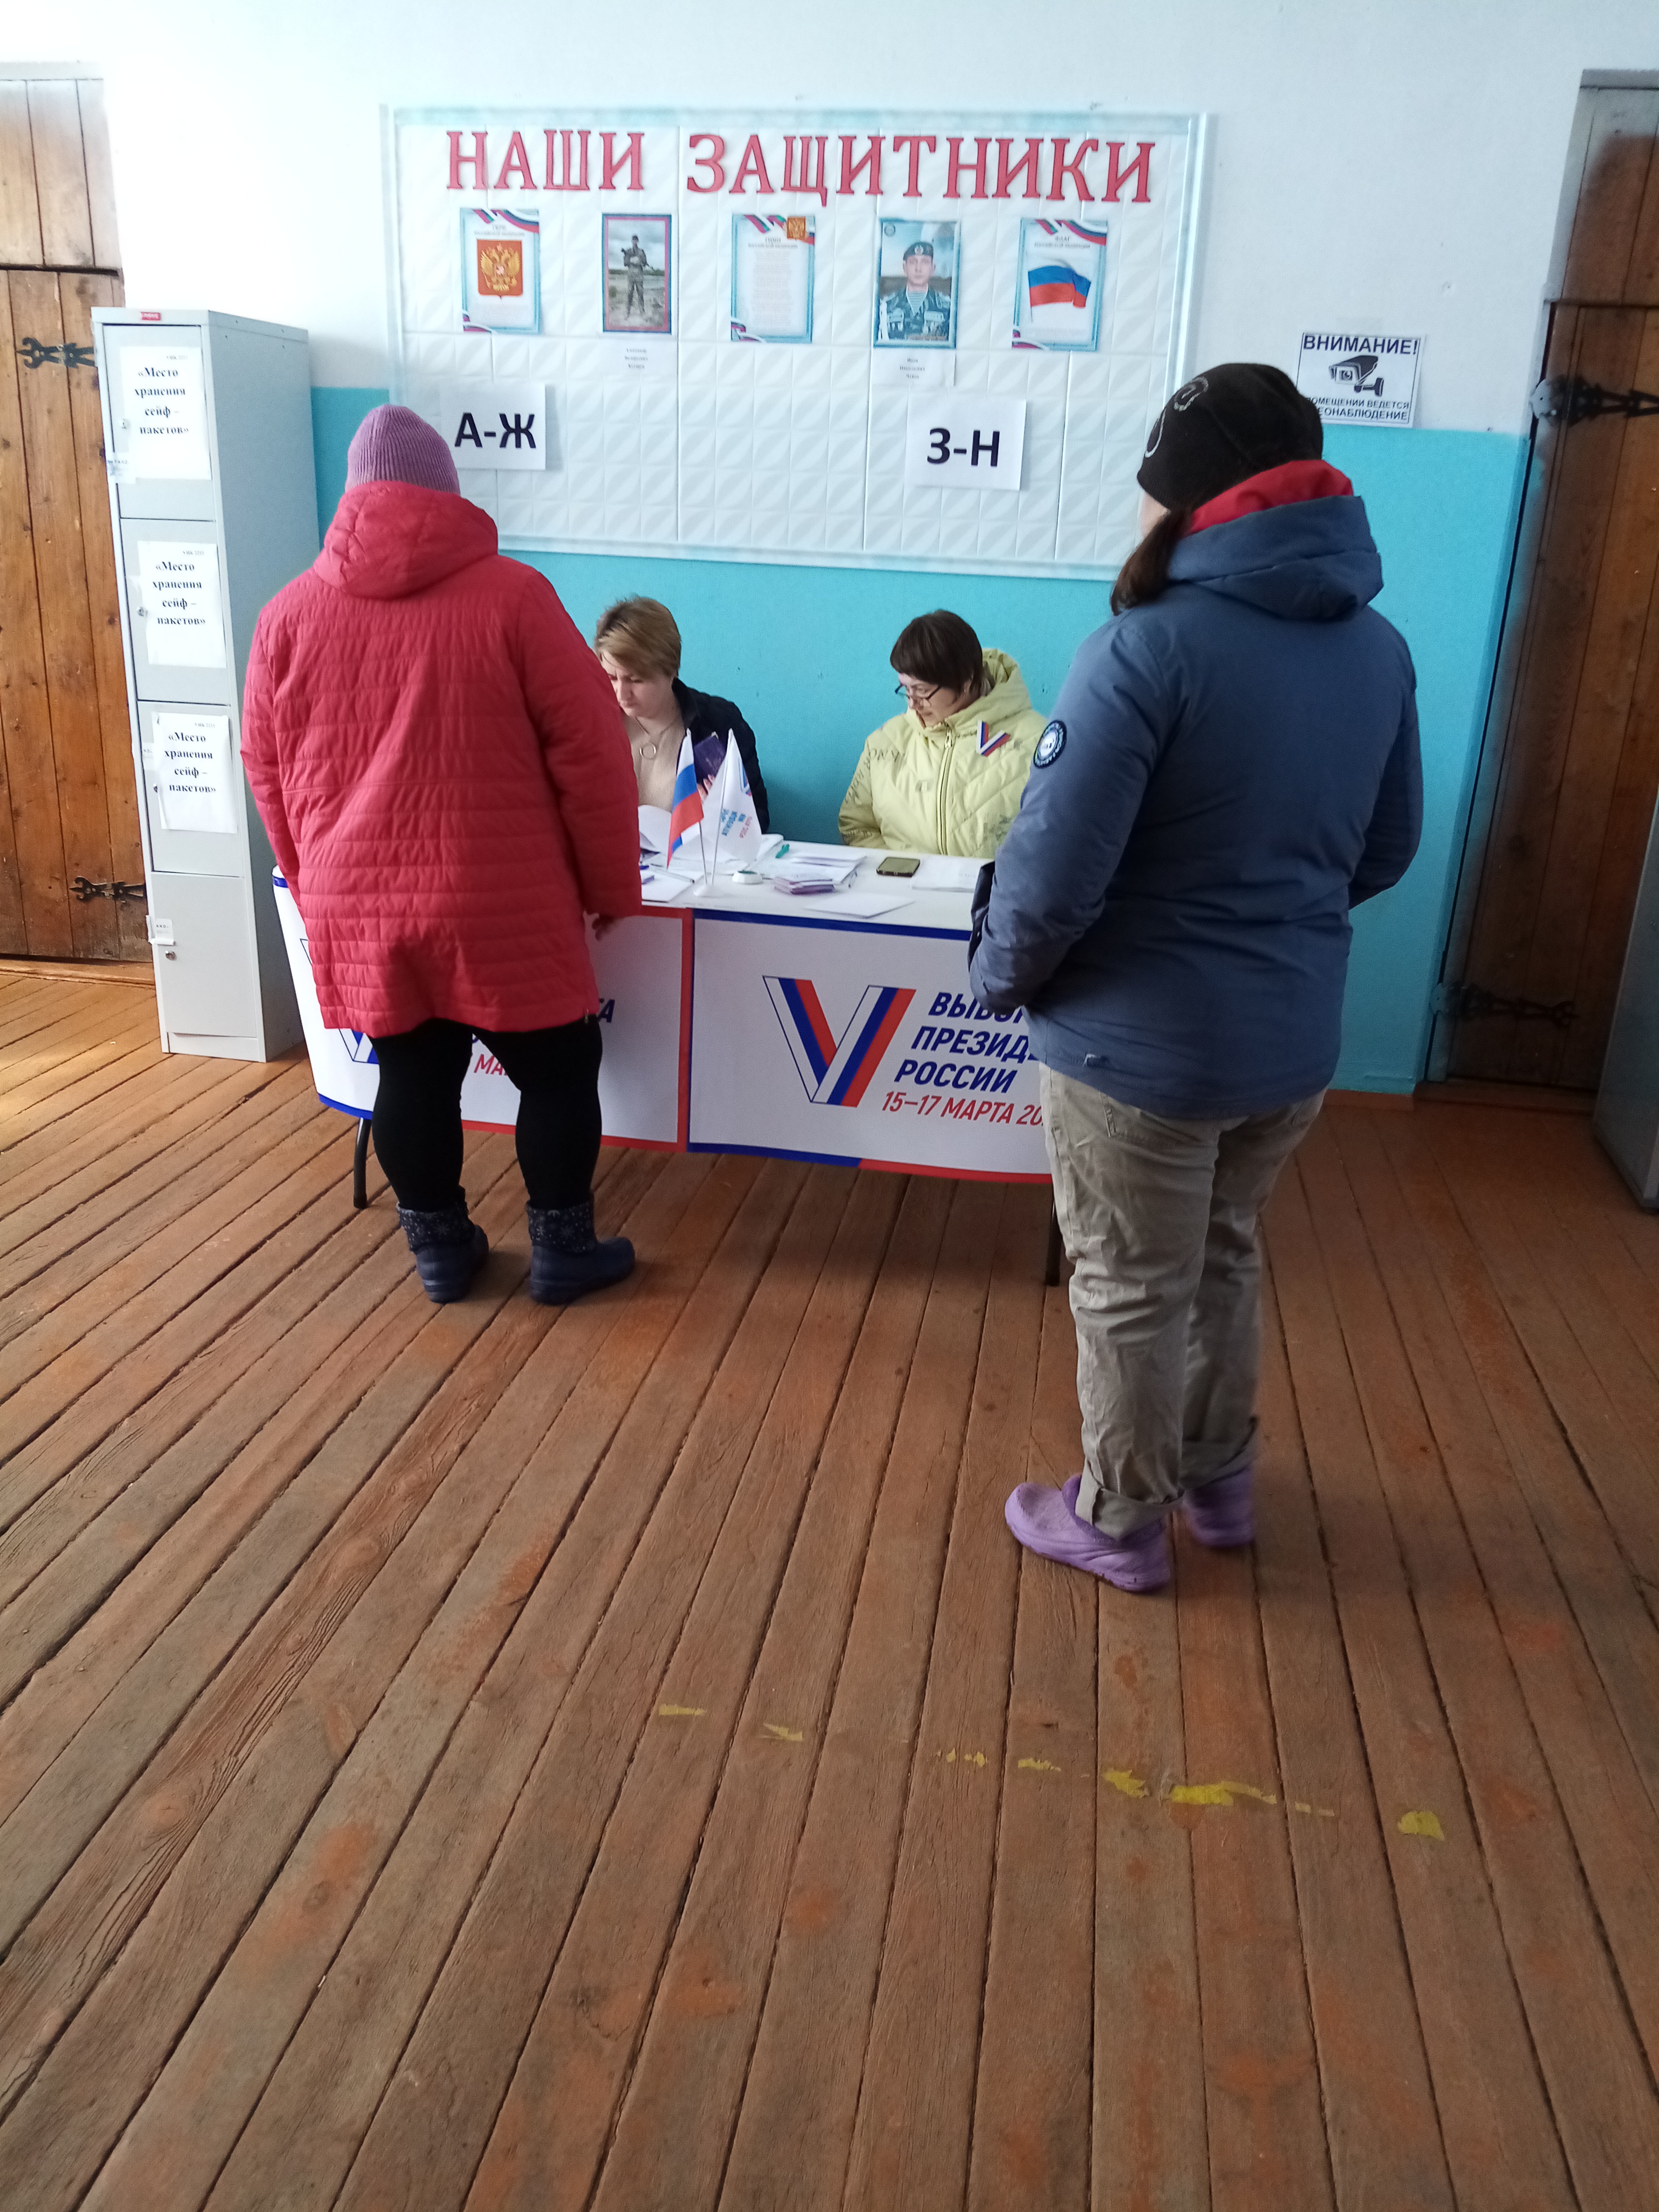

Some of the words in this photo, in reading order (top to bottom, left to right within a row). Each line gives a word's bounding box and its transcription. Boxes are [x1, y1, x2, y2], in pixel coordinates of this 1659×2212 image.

[447, 130, 644, 191] НАШИ
[686, 134, 1155, 207] ЗАЩИТНИКИ
[1303, 335, 1418, 355] ВНИМАНИЕ!
[138, 367, 179, 377] «Место
[134, 388, 186, 399] хранения
[1367, 400, 1409, 410] ВЕДЕТСЯ
[145, 406, 171, 418] сейф
[1318, 407, 1408, 421] ЕОНАБЛЮДЕНИЕ
[454, 412, 536, 448] А-Ж
[927, 428, 1000, 467] З-Н
[156, 561, 195, 571] «Место
[152, 581, 202, 591] хранения
[162, 598, 188, 610] сейф
[168, 731, 206, 742] «Место
[164, 750, 213, 760] хранения
[174, 767, 199, 779] сейф
[169, 784, 216, 793] пакетов»
[910, 1025, 1037, 1064] ПРЕЗИД
[894, 1059, 1017, 1094] РОССИИ
[941, 1097, 1015, 1124] МАРТА
[1016, 1104, 1043, 1126] 20
